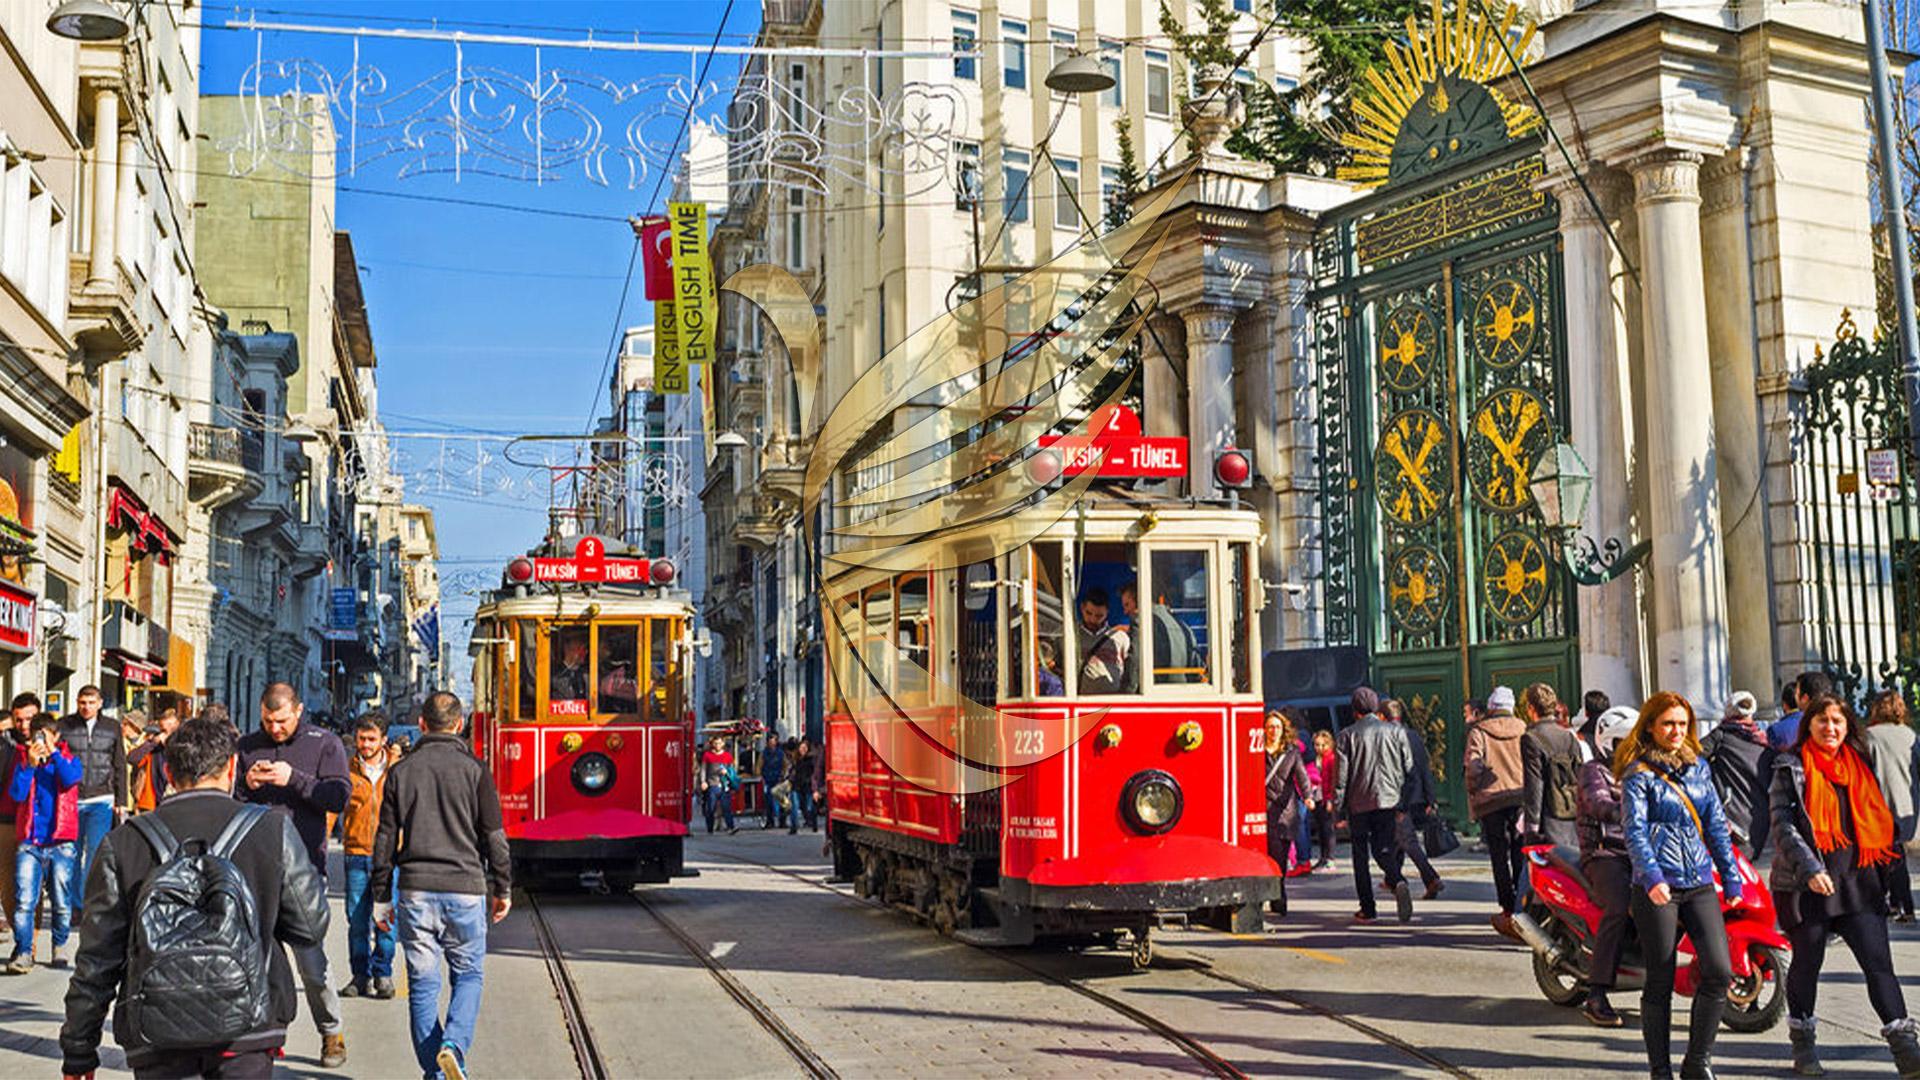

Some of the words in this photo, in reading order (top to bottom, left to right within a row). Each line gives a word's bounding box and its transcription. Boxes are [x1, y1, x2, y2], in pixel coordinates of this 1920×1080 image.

[678, 205, 699, 256] TIME
[681, 266, 707, 360] ENGLISH
[1109, 407, 1121, 430] 2
[1130, 443, 1182, 469] TÜNEL
[585, 540, 595, 557] 3
[537, 562, 577, 580] TAKSİM
[1014, 730, 1044, 755] 223
